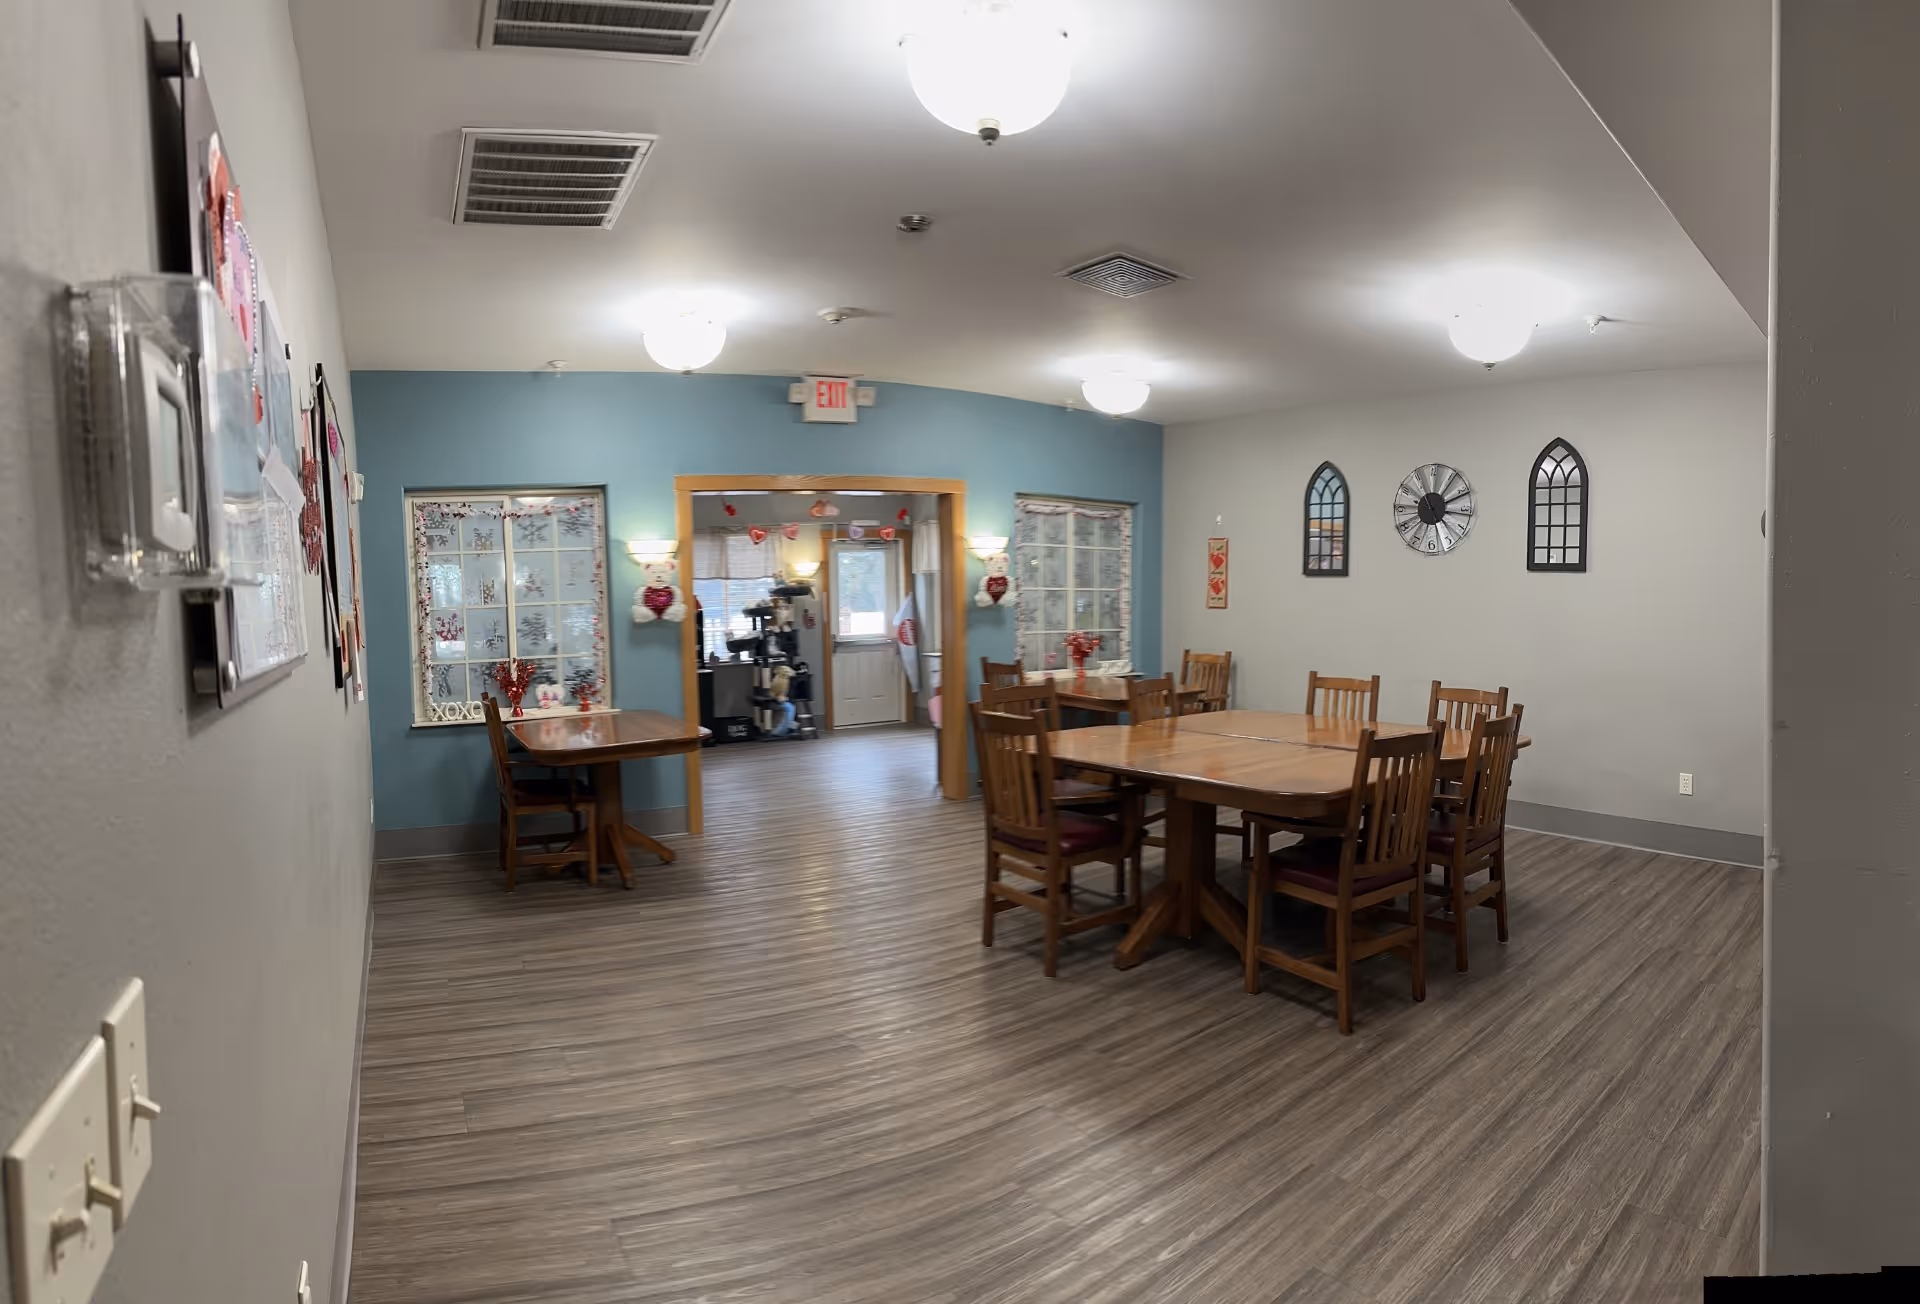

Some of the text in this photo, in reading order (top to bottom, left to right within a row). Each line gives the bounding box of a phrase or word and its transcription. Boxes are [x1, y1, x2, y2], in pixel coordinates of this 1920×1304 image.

[816, 380, 848, 409] EXIT
[1460, 504, 1470, 512] 3
[1400, 522, 1409, 532] 8
[1411, 535, 1421, 545] 7
[1428, 540, 1436, 551] 6
[431, 700, 484, 721] XOXO
